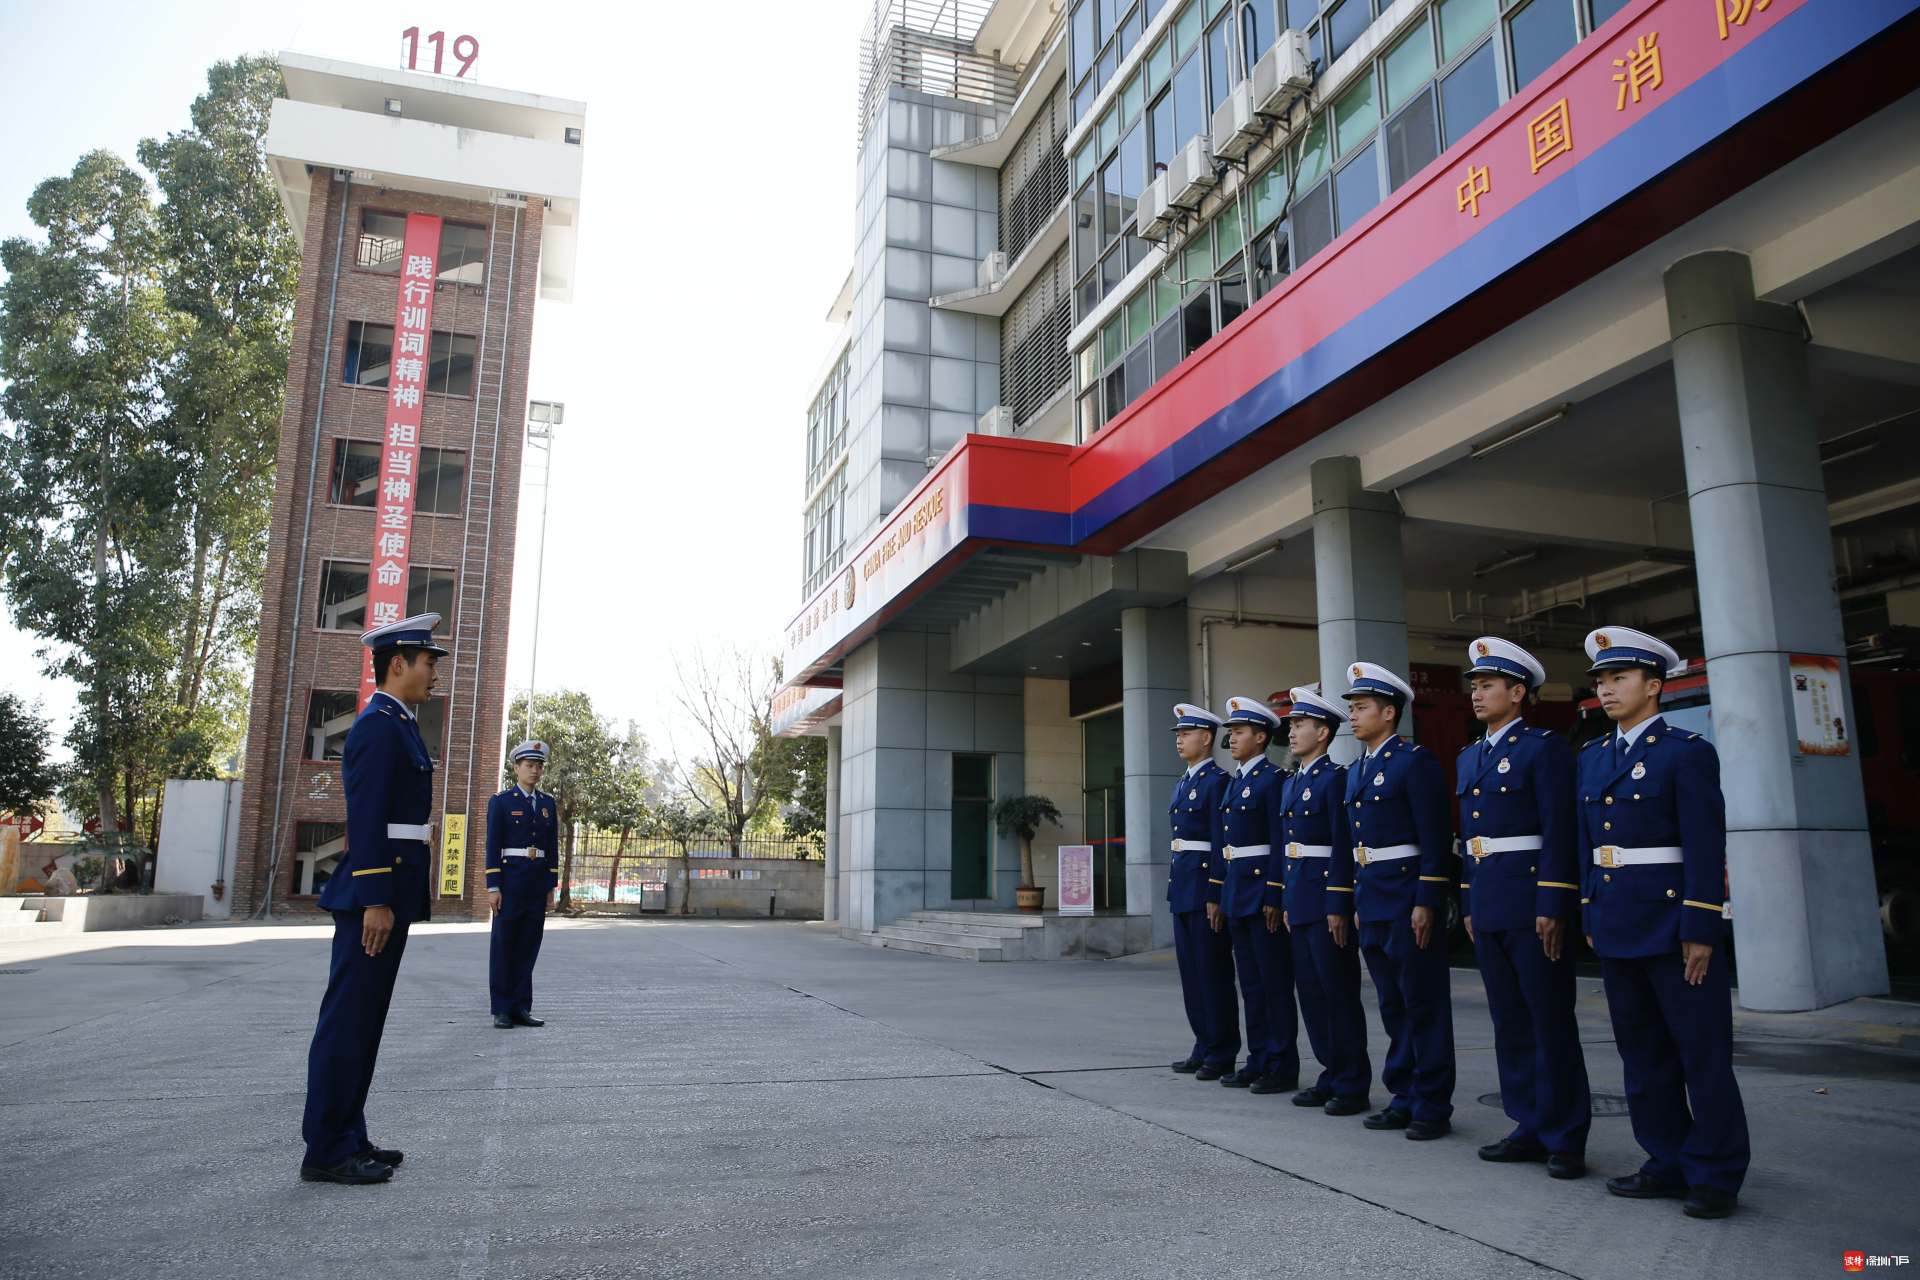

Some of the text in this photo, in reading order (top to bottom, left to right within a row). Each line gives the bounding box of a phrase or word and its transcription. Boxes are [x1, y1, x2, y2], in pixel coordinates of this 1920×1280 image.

[402, 26, 479, 78] 119
[393, 254, 433, 409] 践行训词精神
[376, 422, 416, 586] 担当神圣使命
[863, 549, 881, 581] CHINA
[882, 533, 896, 565] FIRE
[897, 519, 911, 550] AND
[913, 487, 943, 535] RESCUE
[444, 832, 461, 891] 严禁攀爬
